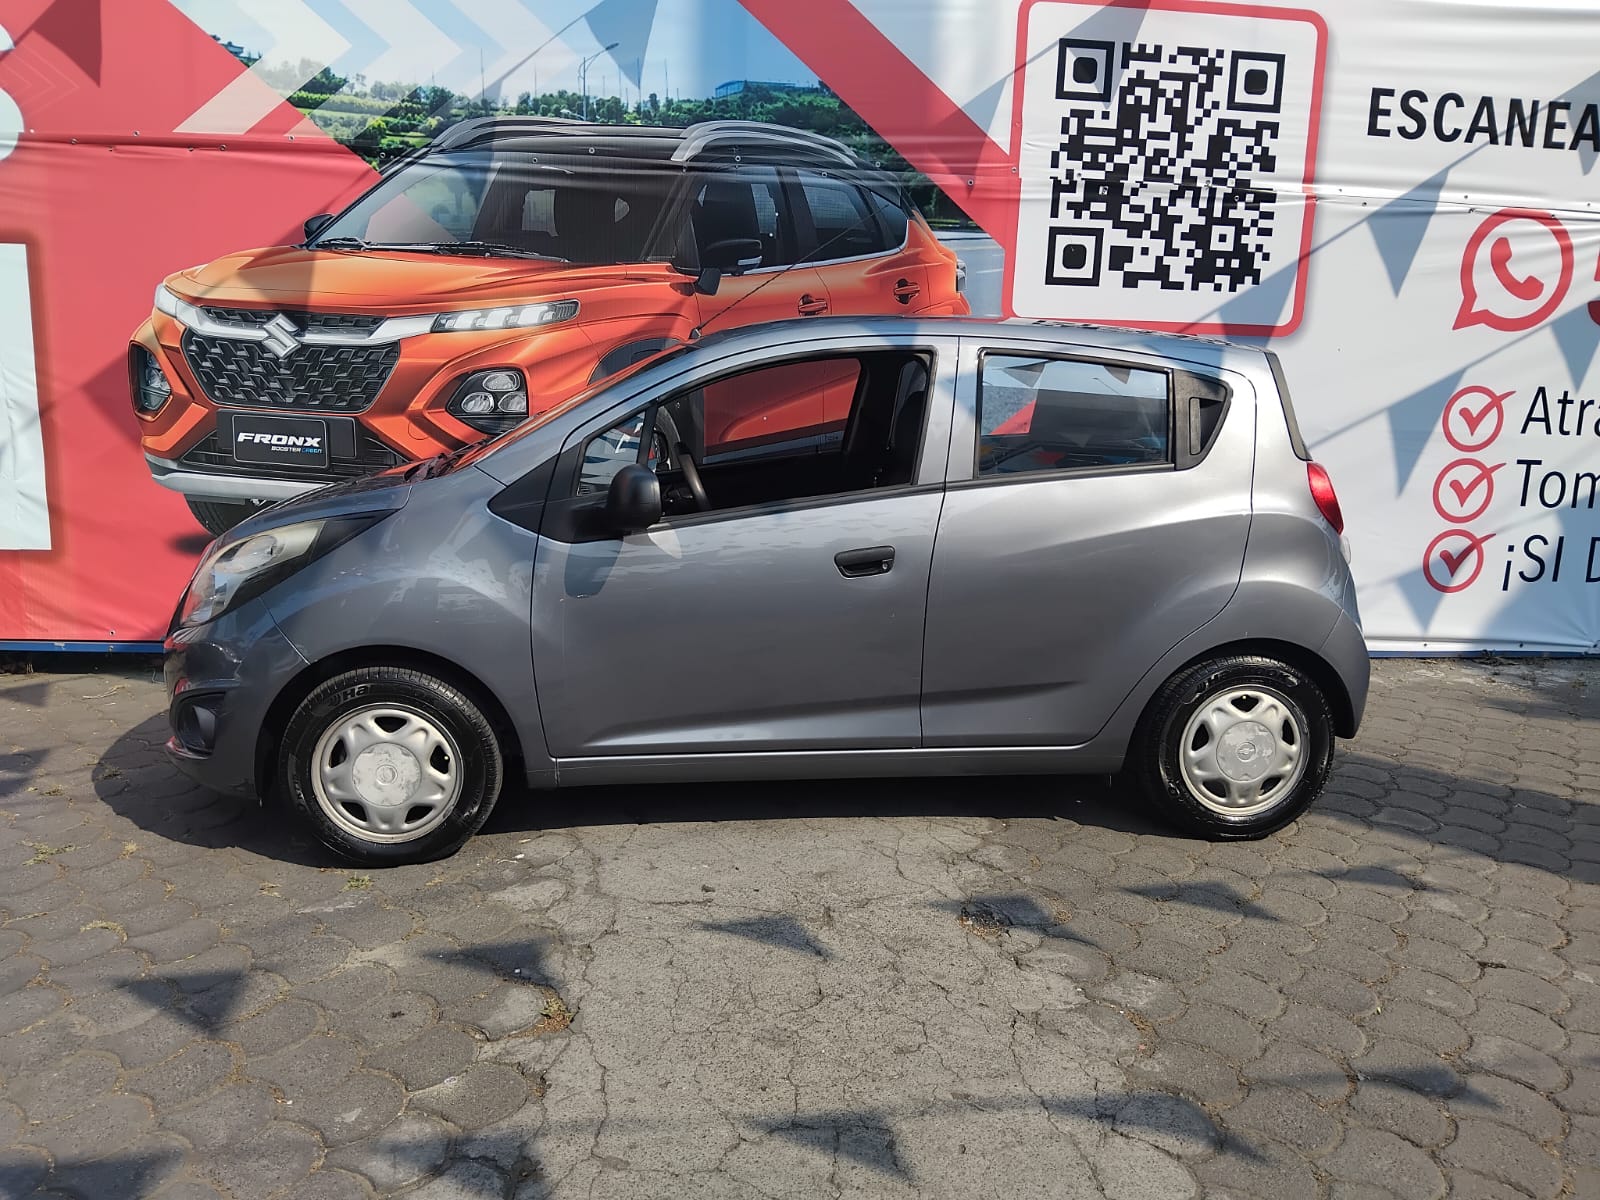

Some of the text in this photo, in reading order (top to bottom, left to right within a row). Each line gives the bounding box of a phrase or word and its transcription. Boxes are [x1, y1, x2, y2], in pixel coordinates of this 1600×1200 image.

[1367, 87, 1600, 152] ESCANEA
[1520, 386, 1600, 436] Atr
[237, 432, 322, 449] FRONX
[1502, 534, 1564, 591] ¡SI
